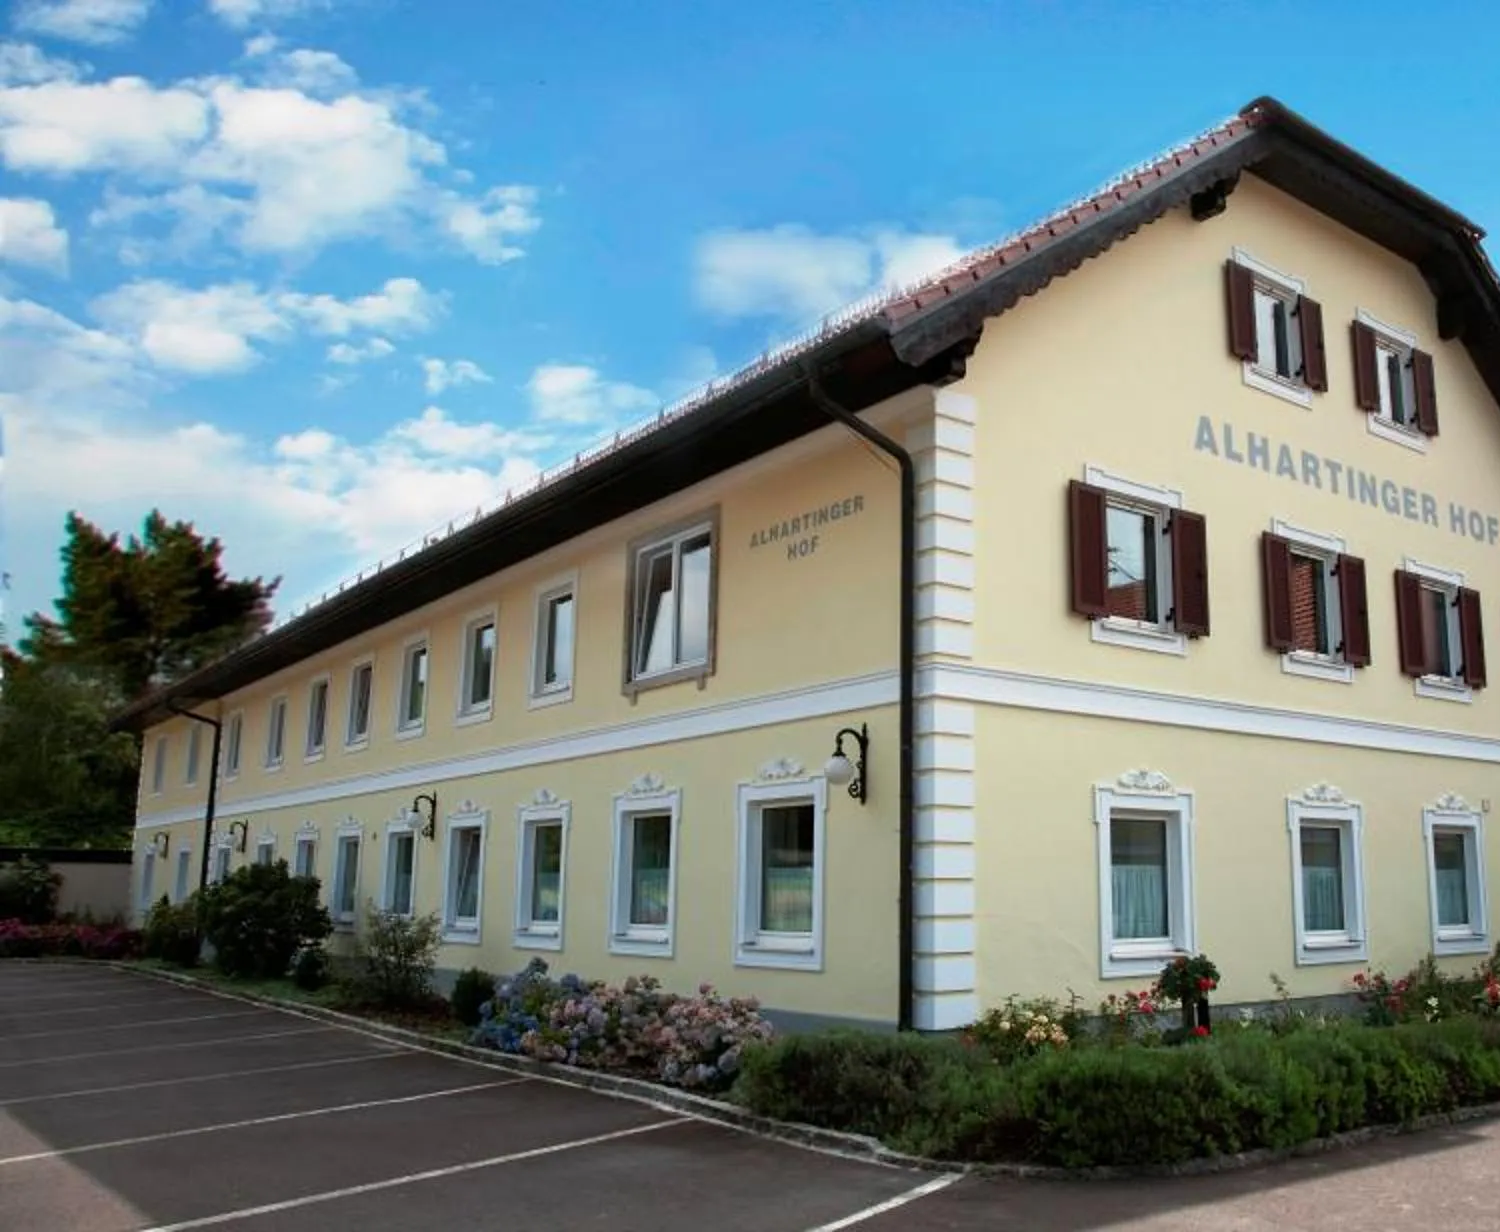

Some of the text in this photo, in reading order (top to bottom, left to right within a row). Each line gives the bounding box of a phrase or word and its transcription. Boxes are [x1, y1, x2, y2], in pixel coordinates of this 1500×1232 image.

[1194, 415, 1499, 546] ALHARTINGER HOF
[750, 495, 864, 548] ALHARTINGER
[787, 535, 820, 561] HOF
